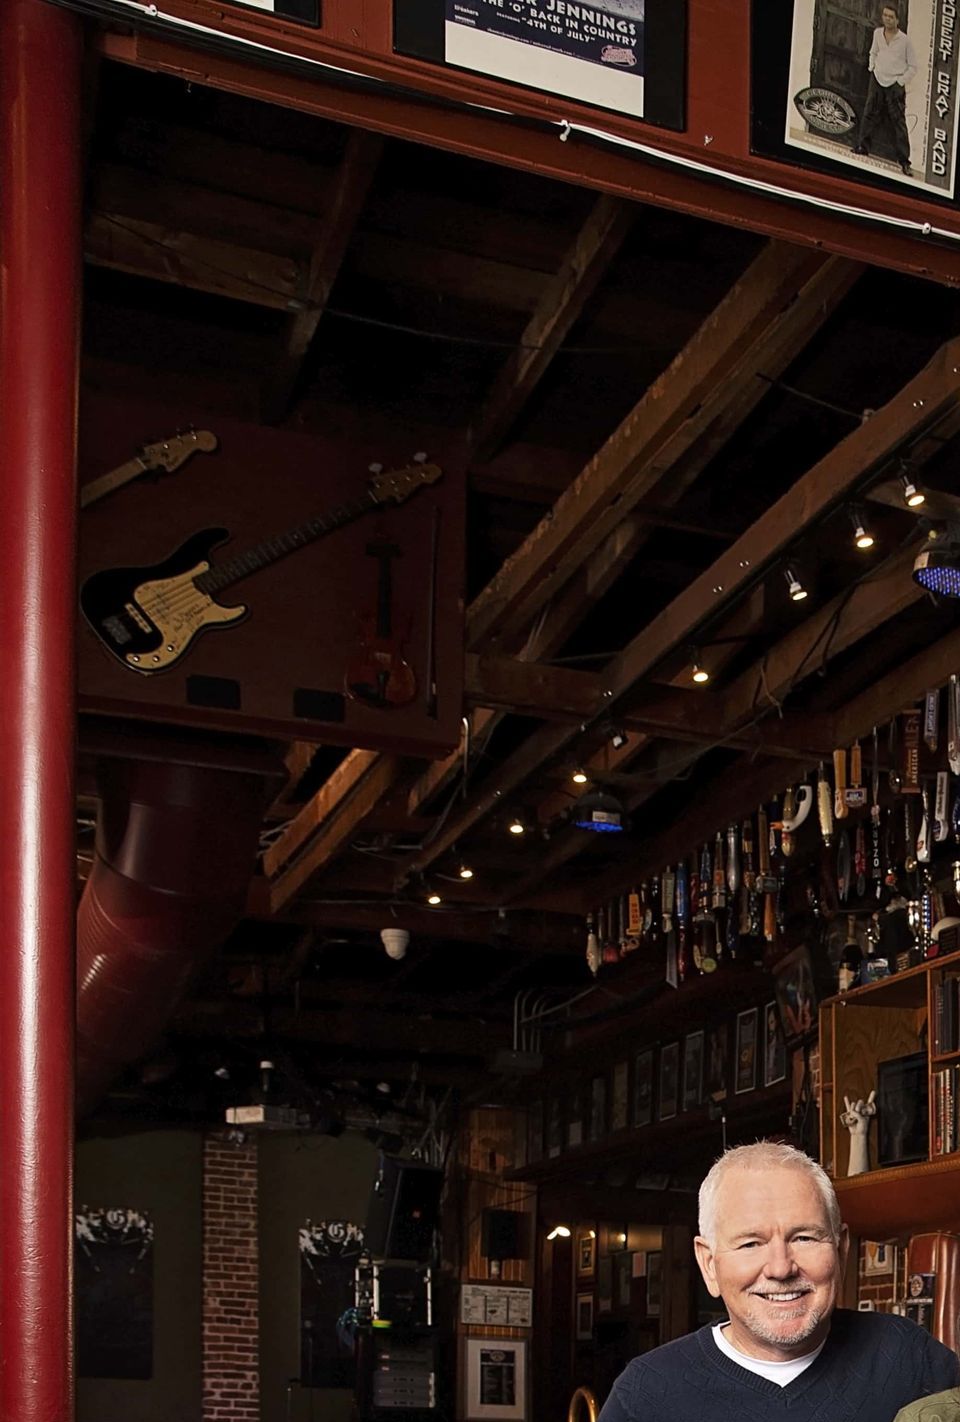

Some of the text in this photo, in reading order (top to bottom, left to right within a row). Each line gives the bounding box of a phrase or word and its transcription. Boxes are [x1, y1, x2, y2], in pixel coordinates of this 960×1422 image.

[530, 8, 560, 25] BACK
[566, 16, 579, 30] IN
[583, 24, 637, 47] COUNTRY
[546, 0, 637, 36] JENNINGS
[550, 25, 564, 35] OF
[934, 71, 951, 118] CRAY
[932, 127, 947, 176] BAND
